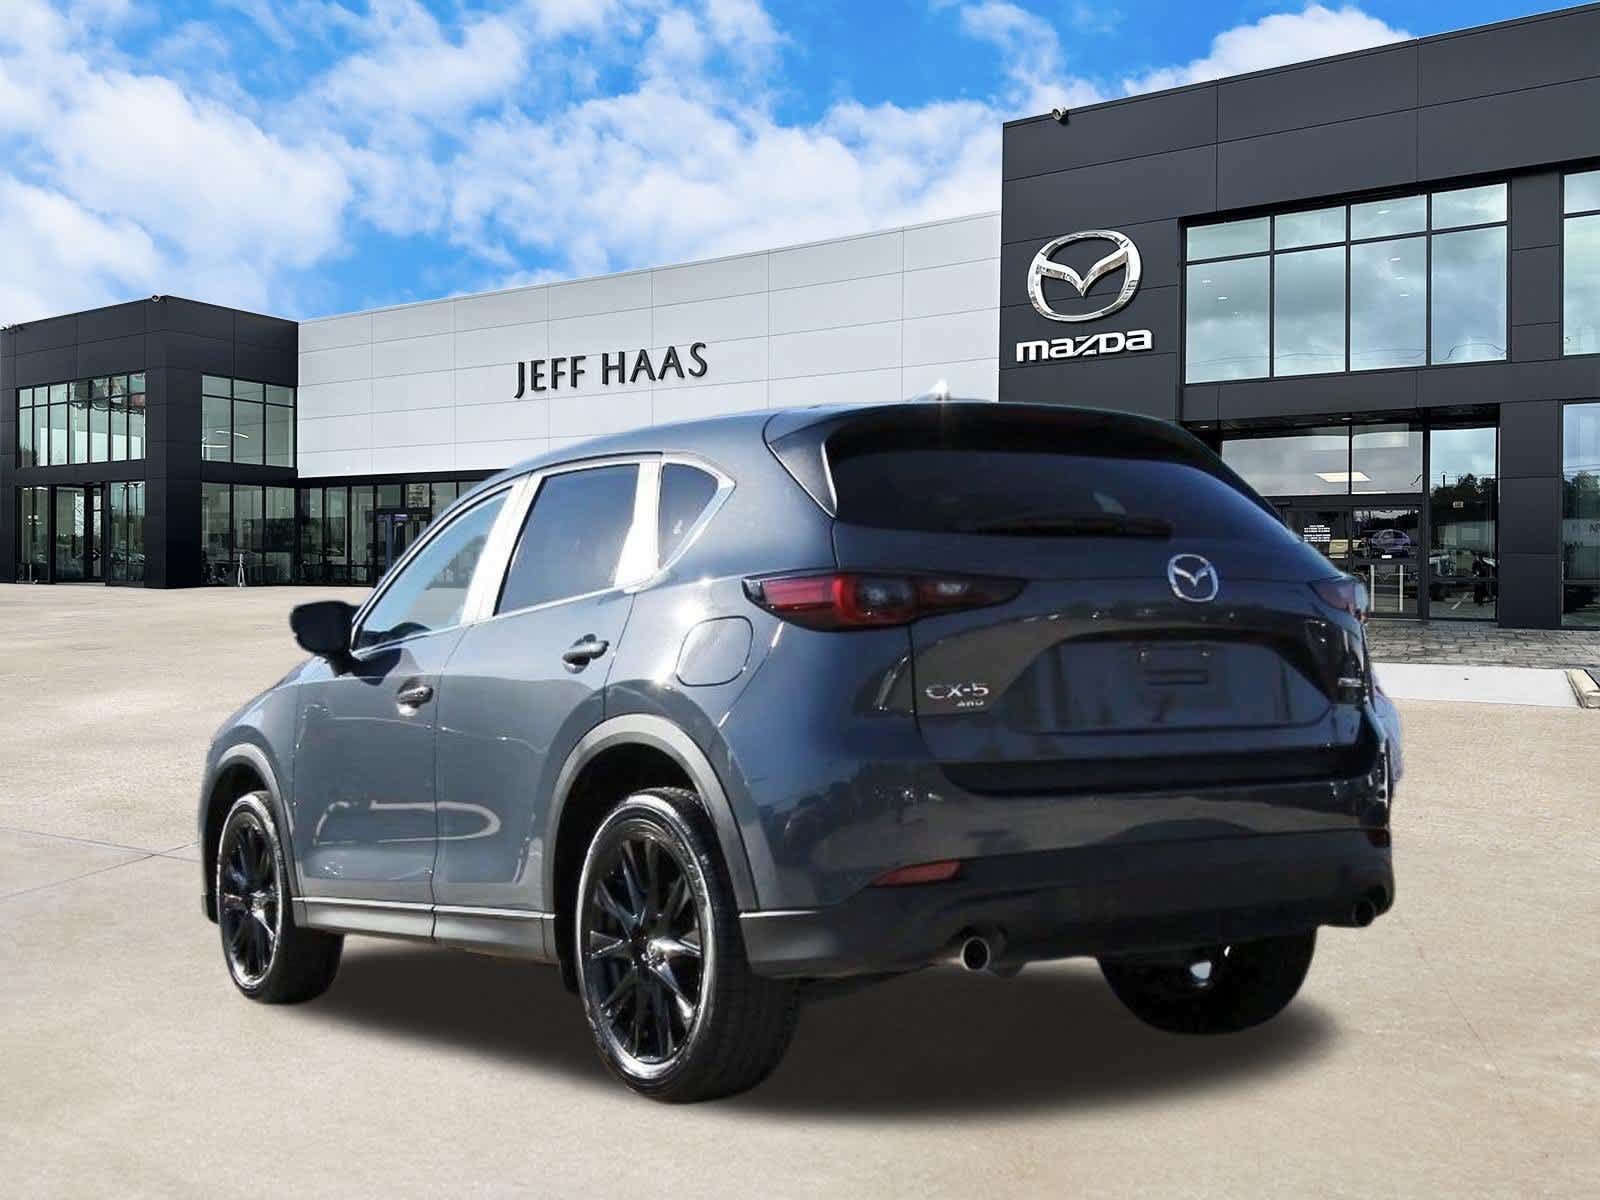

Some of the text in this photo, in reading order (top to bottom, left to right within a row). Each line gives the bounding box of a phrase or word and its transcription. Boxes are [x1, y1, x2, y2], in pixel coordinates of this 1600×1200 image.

[514, 342, 708, 399] JEFF HAAS
[925, 683, 989, 699] CX-5
